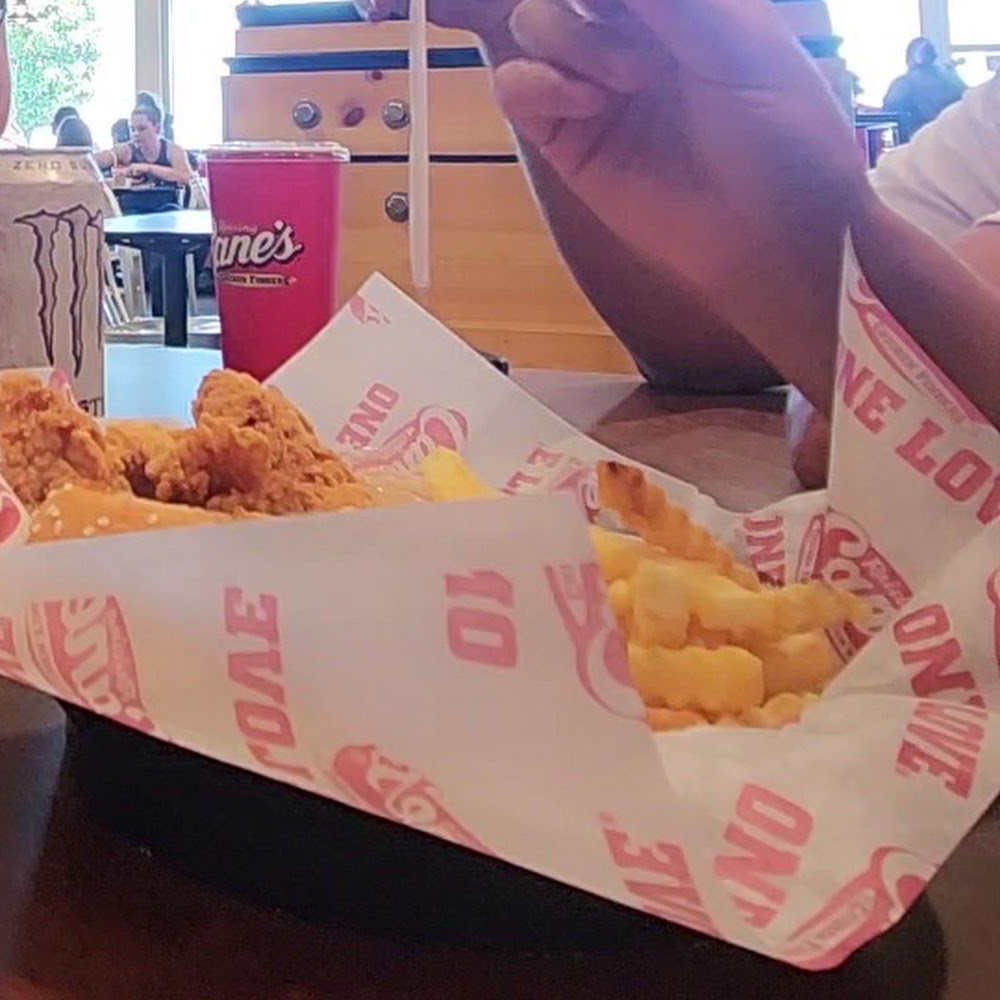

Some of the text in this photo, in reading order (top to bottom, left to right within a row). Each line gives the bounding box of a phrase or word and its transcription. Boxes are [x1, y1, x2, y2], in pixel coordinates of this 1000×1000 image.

[214, 219, 303, 269] ane's
[334, 382, 402, 448] ONE
[838, 347, 906, 436] NE
